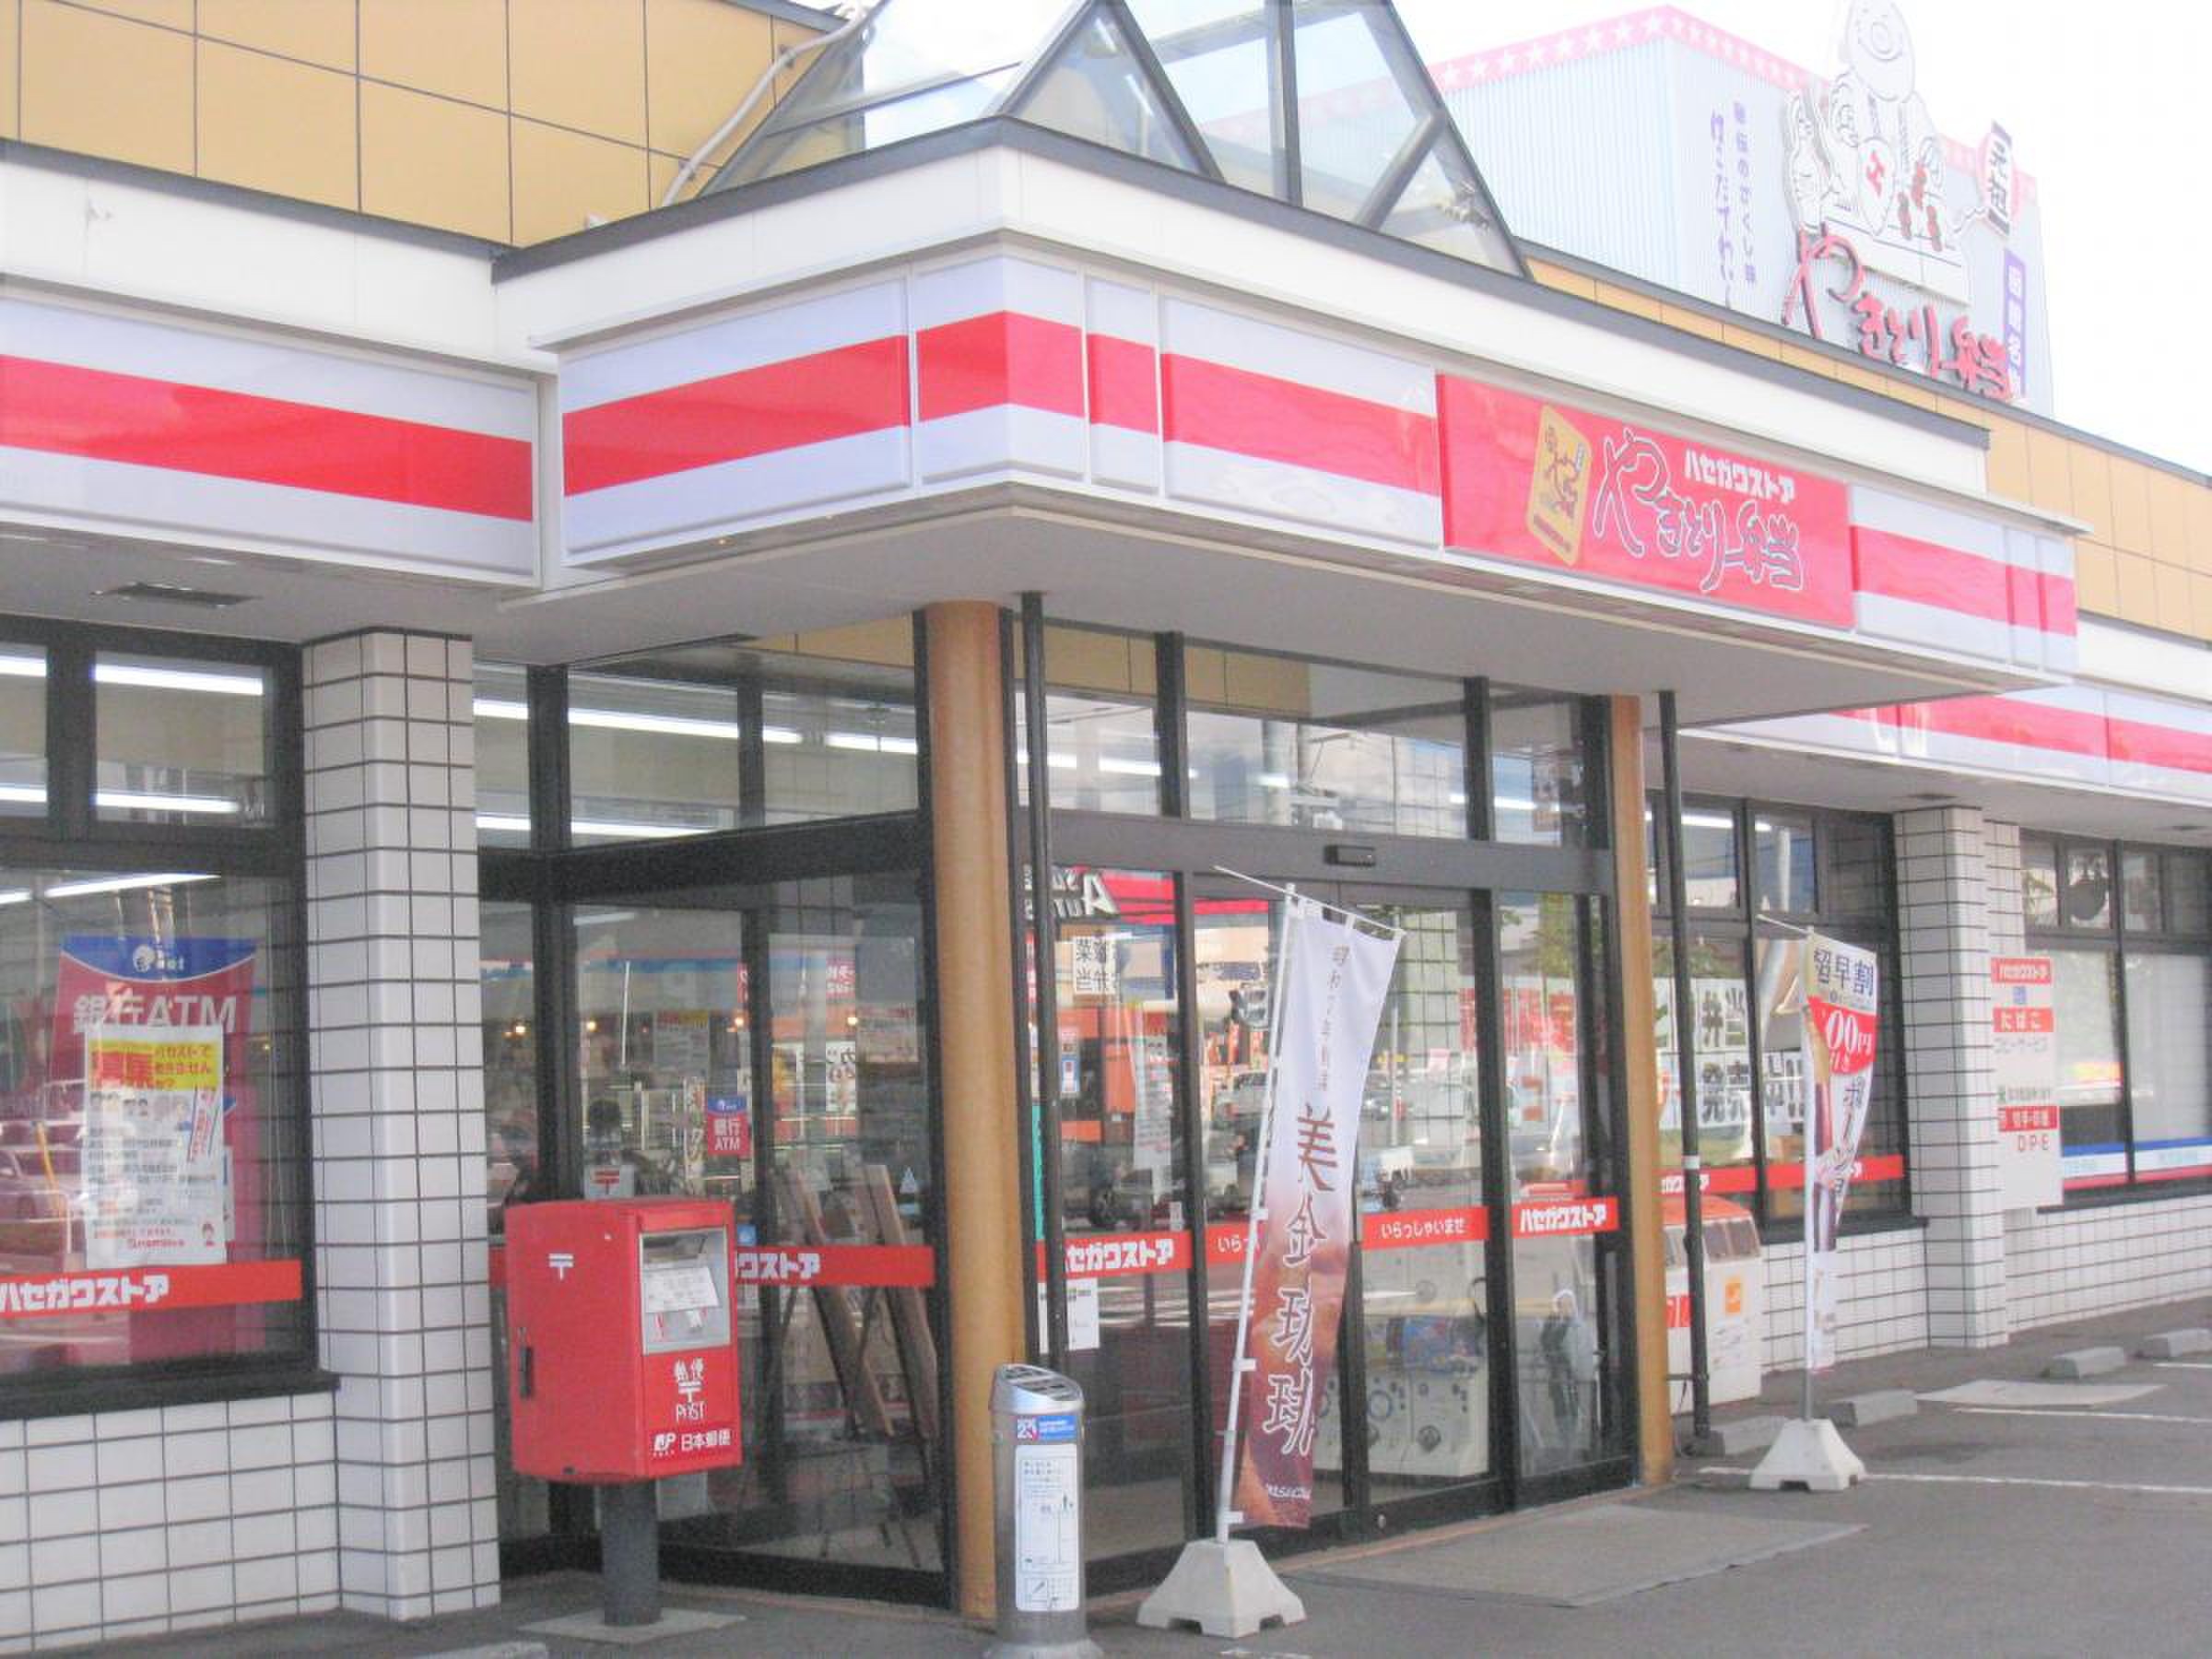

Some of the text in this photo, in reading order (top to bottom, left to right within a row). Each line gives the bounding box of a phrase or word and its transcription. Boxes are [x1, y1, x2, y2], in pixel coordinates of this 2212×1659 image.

[1685, 448, 1795, 504] ハセガワストア
[1593, 427, 1804, 593] やきとり弁当
[714, 1136, 741, 1151] ATM
[1381, 1218, 1467, 1239] いらっしゃいませ
[1520, 1204, 1607, 1232] ハセガワストア
[1065, 1238, 1175, 1274] セガワストア
[0, 1275, 170, 1313] ハセガワストア
[681, 1429, 732, 1453] 日本郵便
